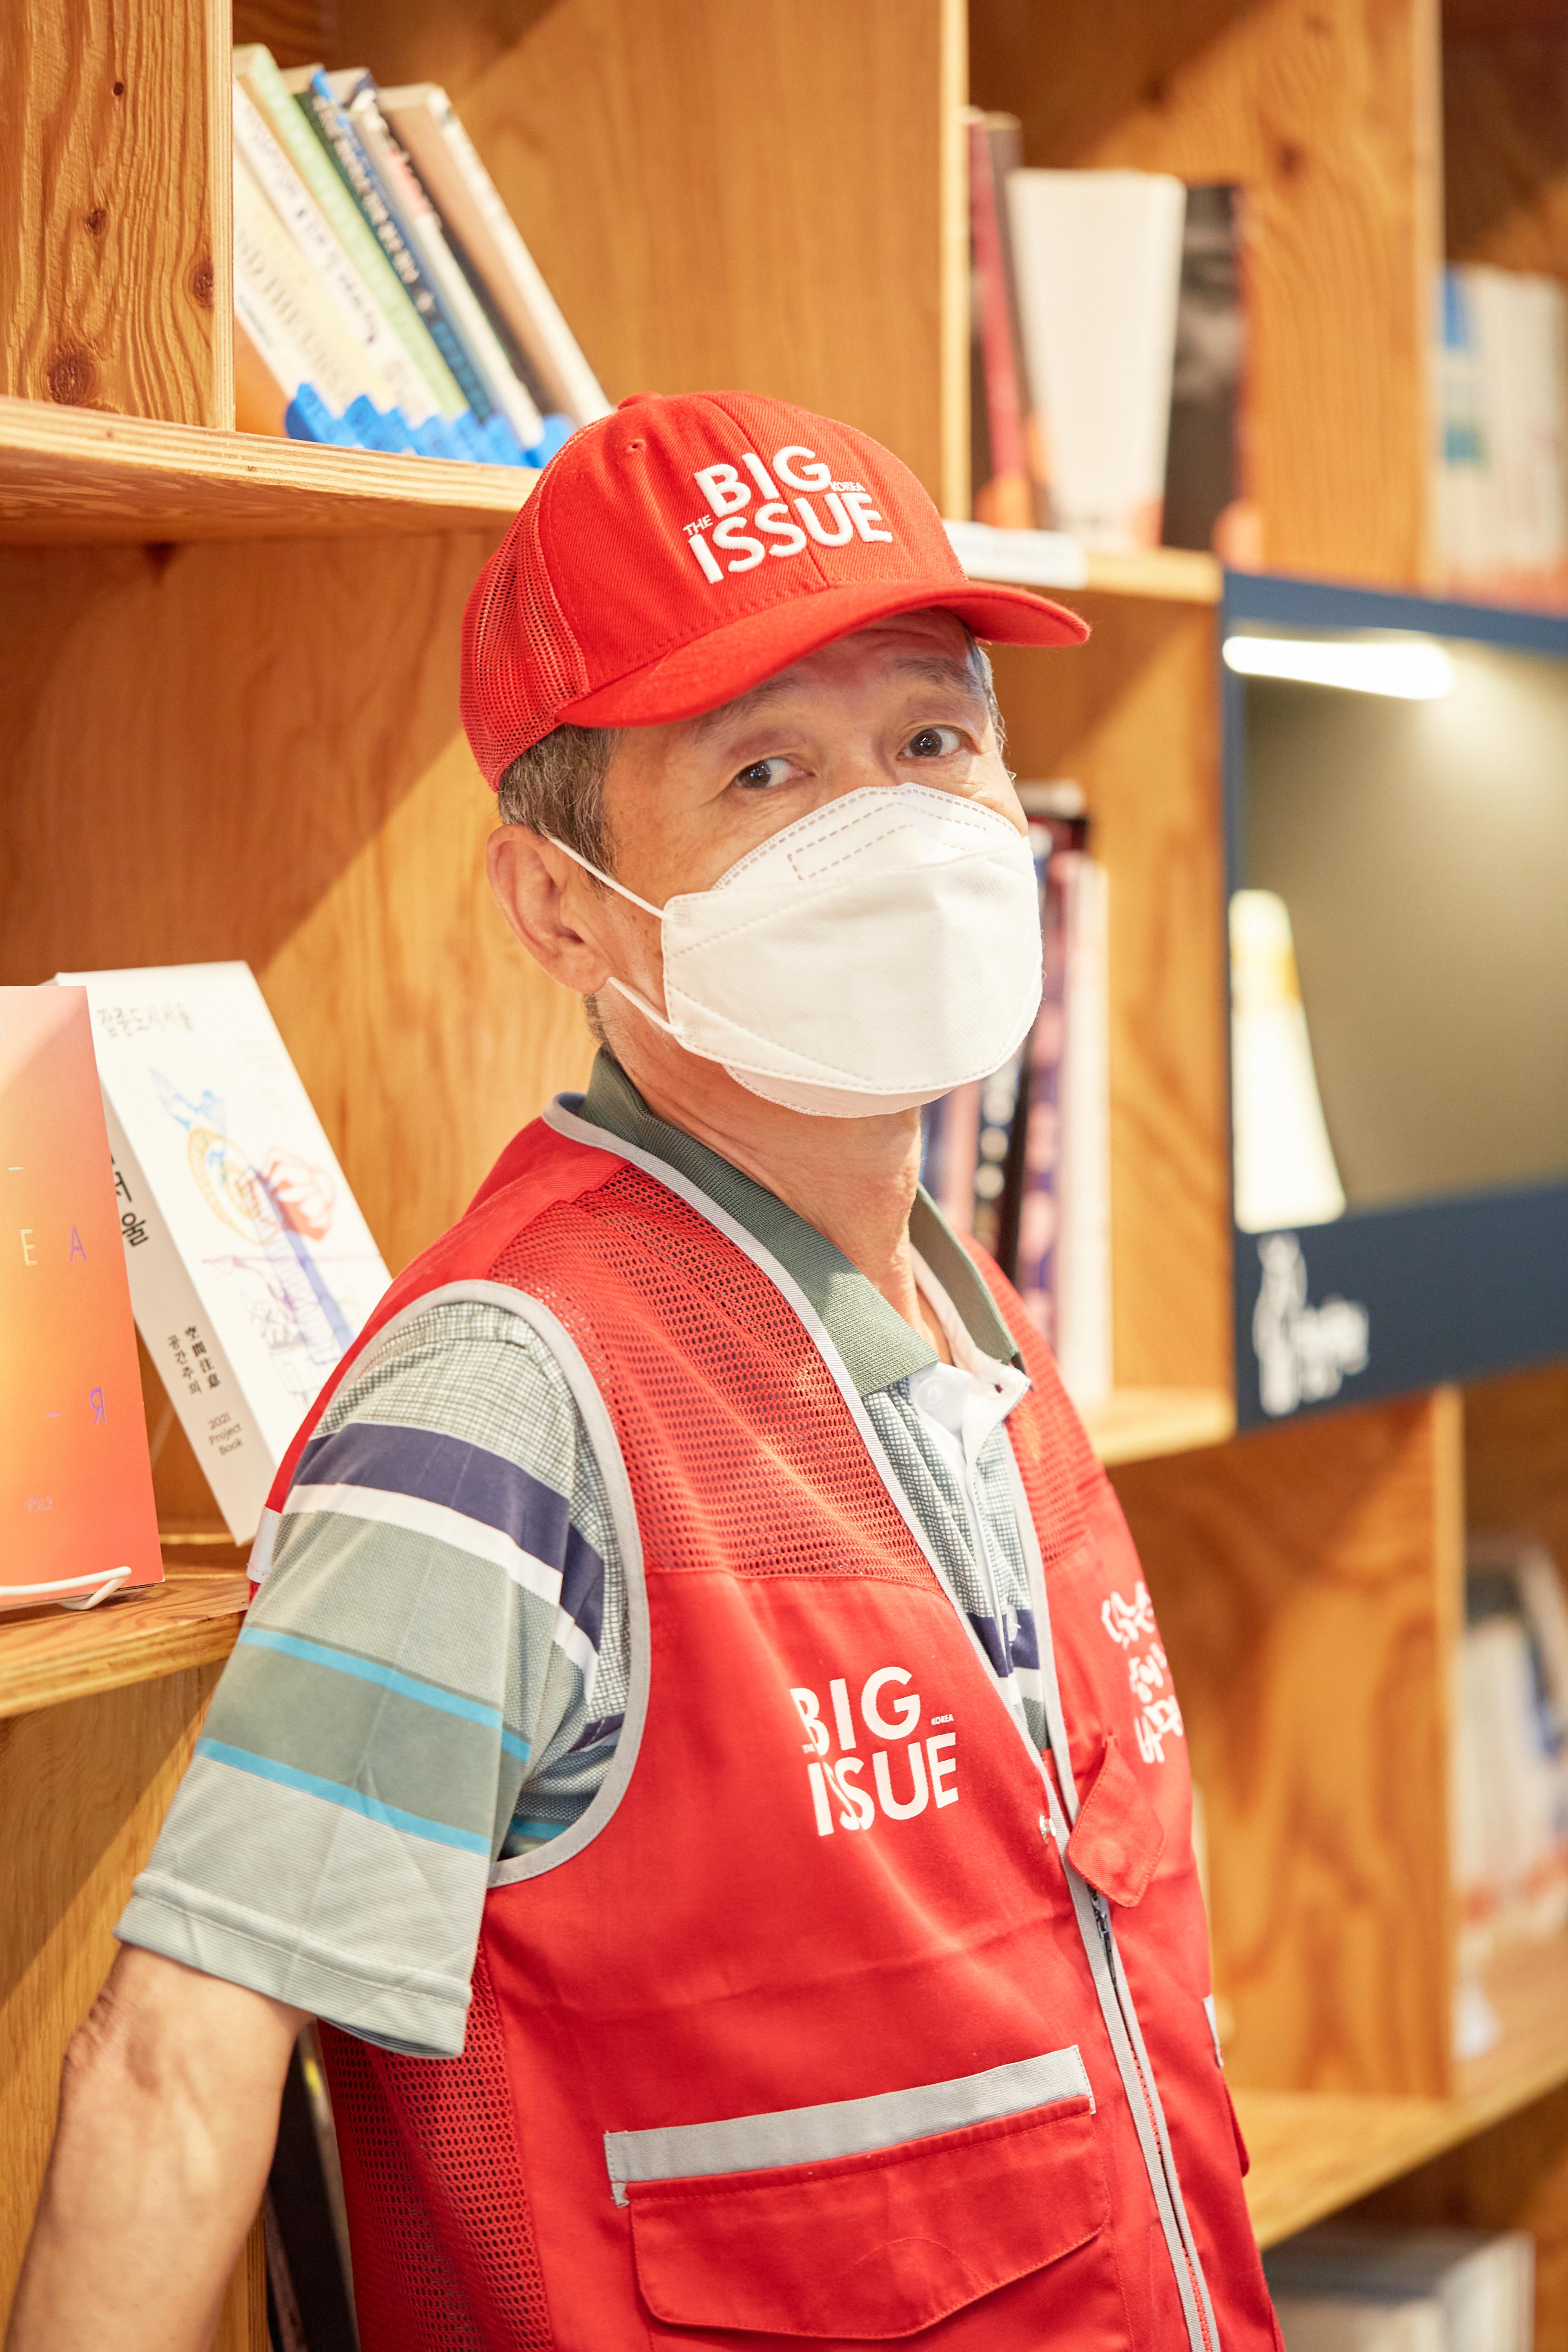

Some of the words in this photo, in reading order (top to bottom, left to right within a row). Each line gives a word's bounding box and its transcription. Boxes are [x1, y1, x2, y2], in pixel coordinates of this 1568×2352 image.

[694, 445, 831, 517] BIG
[829, 481, 866, 492] KOREA
[682, 514, 714, 535] THE
[688, 492, 893, 584] ISSUE
[209, 1412, 231, 1430] 2021
[209, 1423, 242, 1445] Project
[219, 1437, 244, 1455] Book
[790, 1666, 921, 1756] BIG
[931, 1714, 954, 1726] KOREA
[807, 1732, 959, 1837] ISSUE
